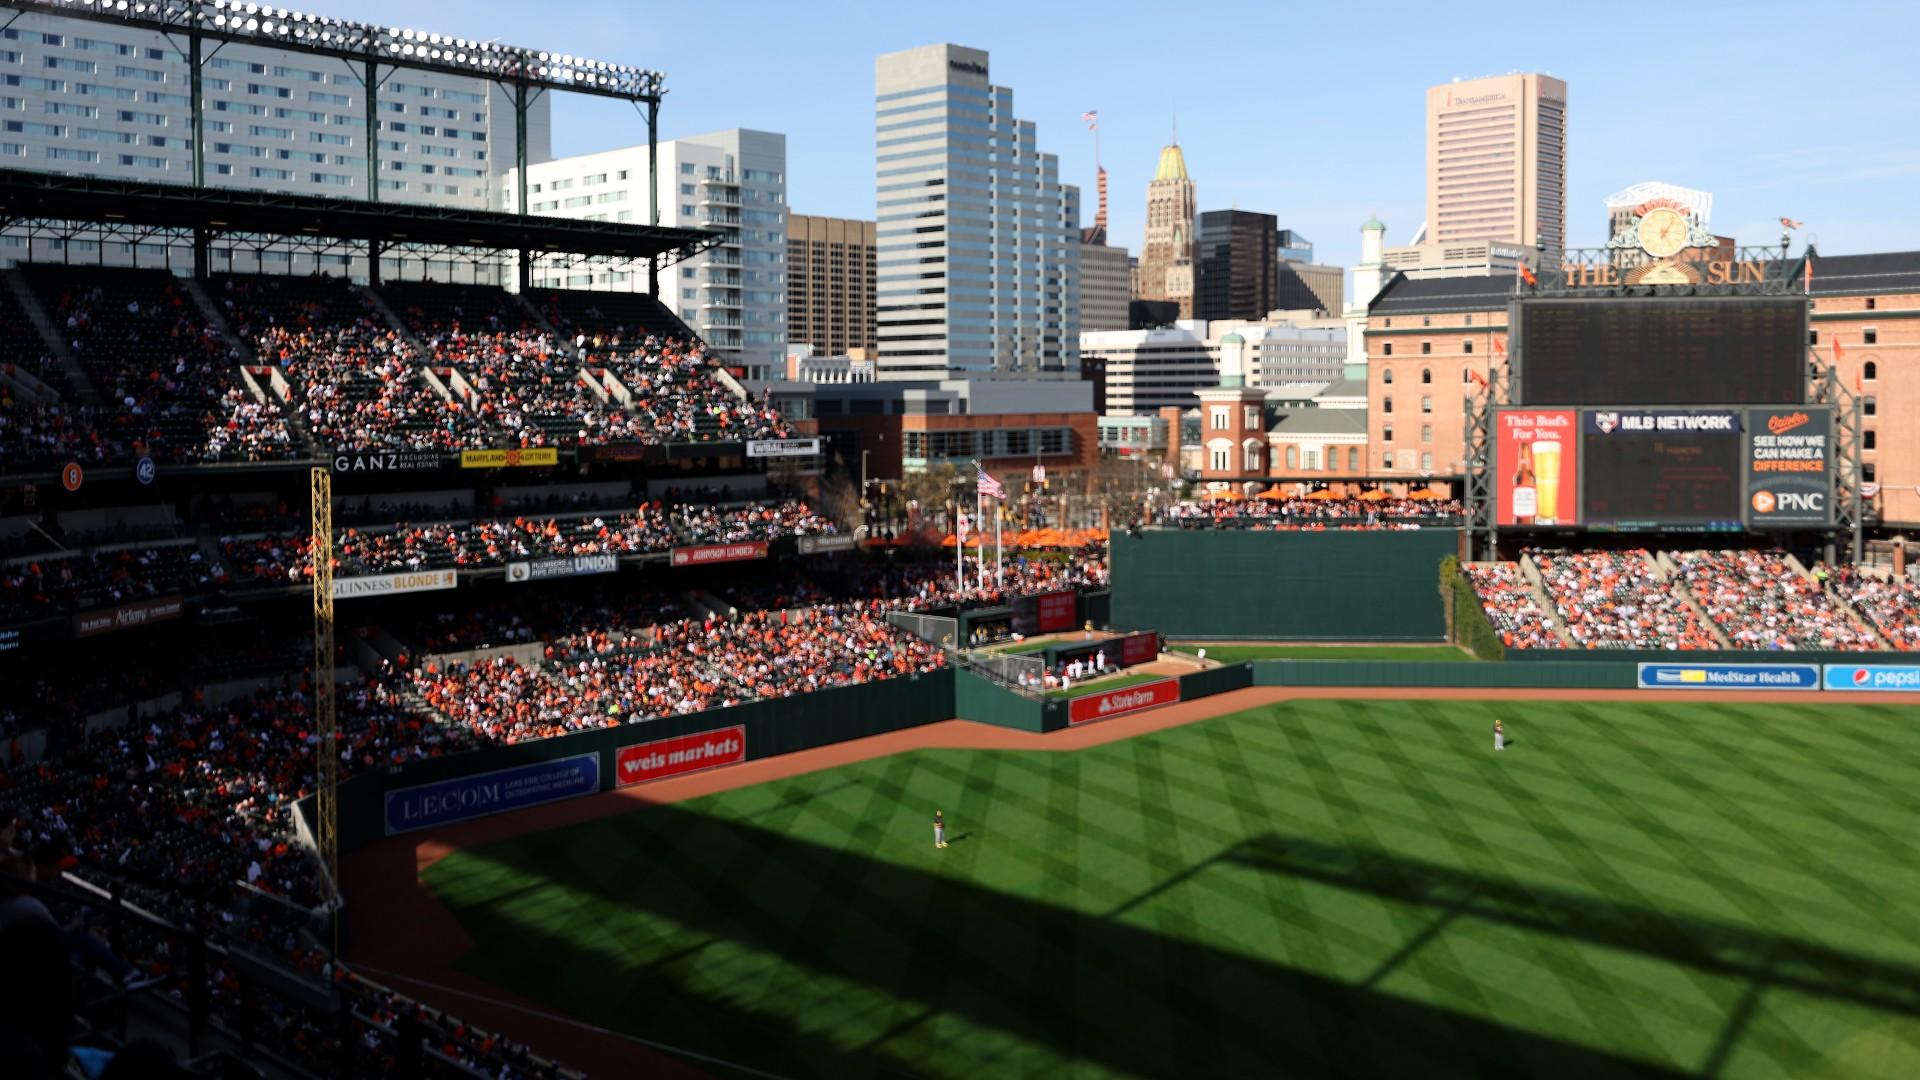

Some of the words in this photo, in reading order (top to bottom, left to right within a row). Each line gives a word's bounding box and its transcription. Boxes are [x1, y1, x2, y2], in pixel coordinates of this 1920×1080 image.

[1562, 262, 1619, 286] THE
[1707, 260, 1765, 285] SUN
[1504, 415, 1534, 426] This
[1621, 415, 1654, 430] MLB
[1657, 415, 1732, 430] NETWORK
[1512, 428, 1532, 439] For
[1534, 428, 1562, 439] You.
[1753, 435, 1776, 447] SEE
[1777, 435, 1805, 447] HOW
[1804, 435, 1825, 447] WE
[1754, 448, 1779, 459] CAN
[1780, 448, 1813, 459] MAKE
[1813, 448, 1824, 459] A
[140, 463, 153, 479] 42
[335, 454, 398, 472] GANZ
[1753, 460, 1825, 471] DIFFERENCE
[70, 468, 77, 484] 8
[1776, 492, 1824, 511] PNC
[575, 556, 616, 572] UNION
[393, 572, 440, 589] BLONDE
[1707, 671, 1757, 683] MedStar
[1759, 671, 1800, 684] Health
[1875, 670, 1920, 688] pepsi
[624, 752, 666, 773] weis
[668, 739, 739, 764] markets
